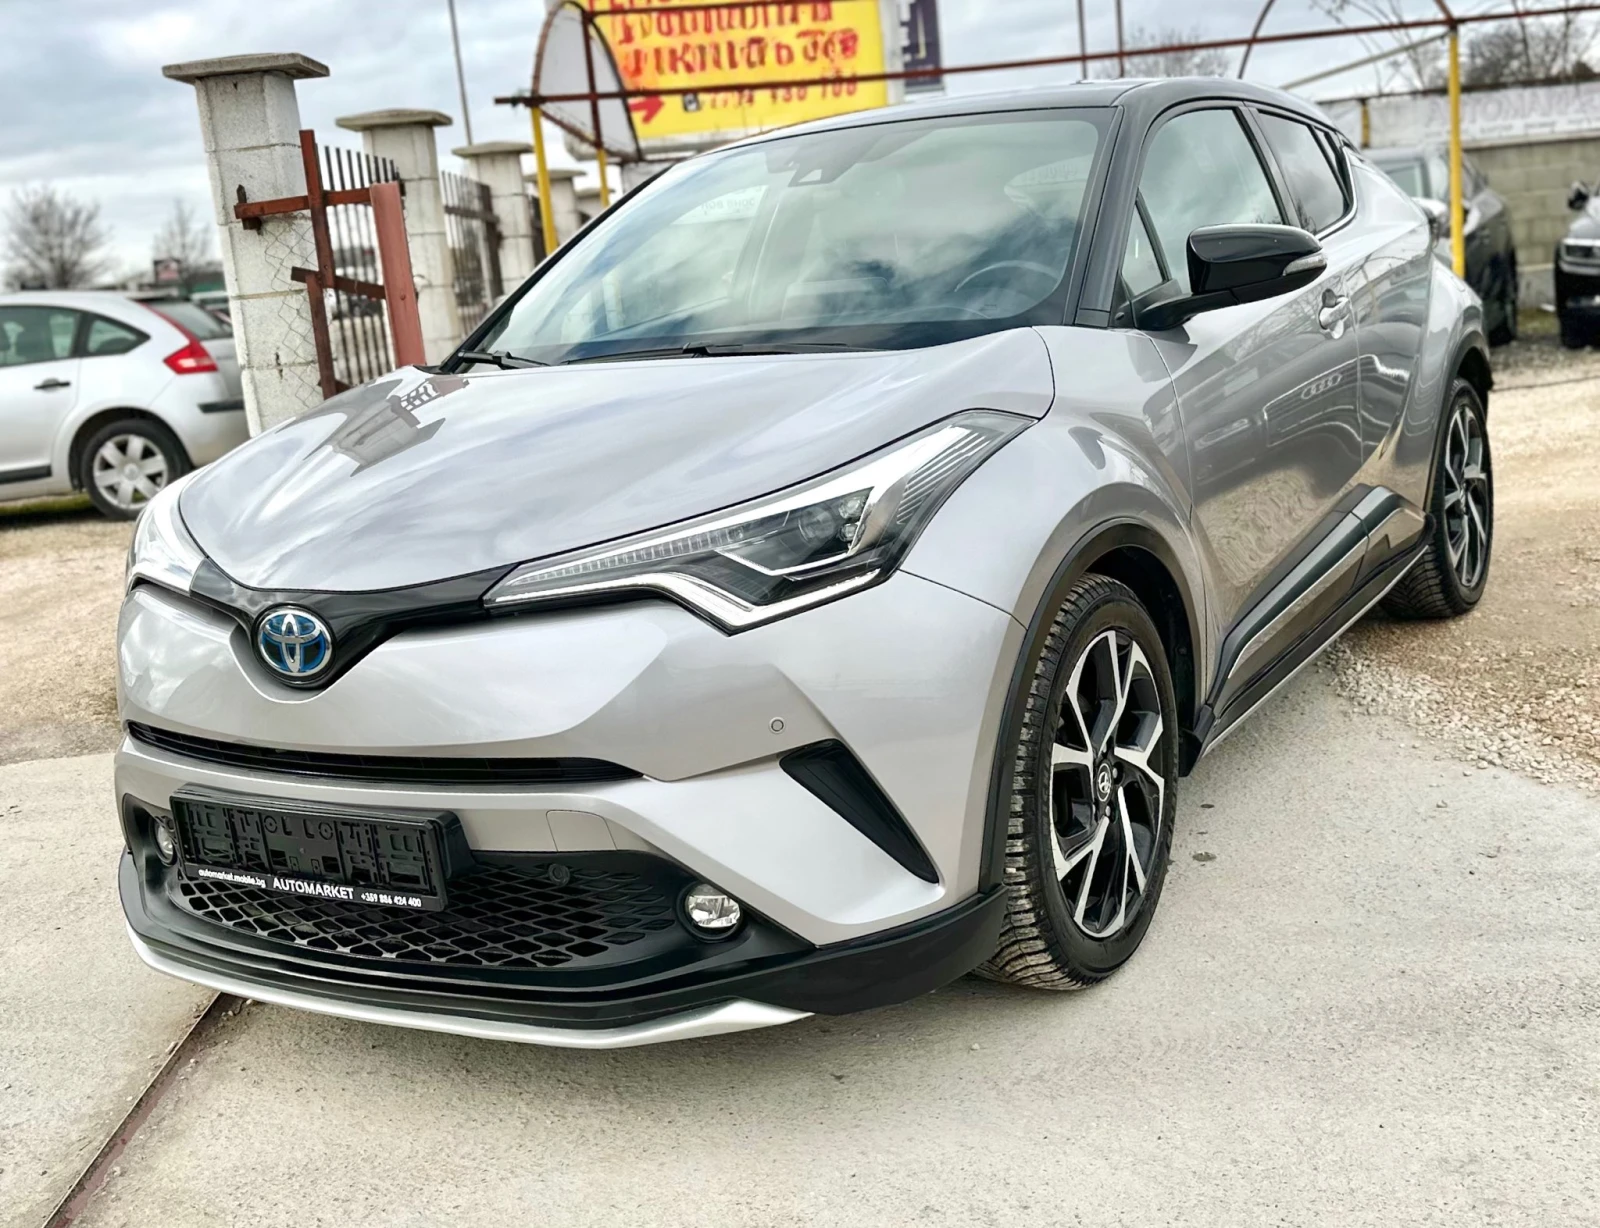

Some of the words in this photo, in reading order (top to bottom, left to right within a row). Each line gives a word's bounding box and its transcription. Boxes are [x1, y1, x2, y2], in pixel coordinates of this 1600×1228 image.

[198, 868, 266, 889] automarket.mobile.bg
[272, 876, 354, 900] AUTOMARKET
[361, 892, 378, 902] +359
